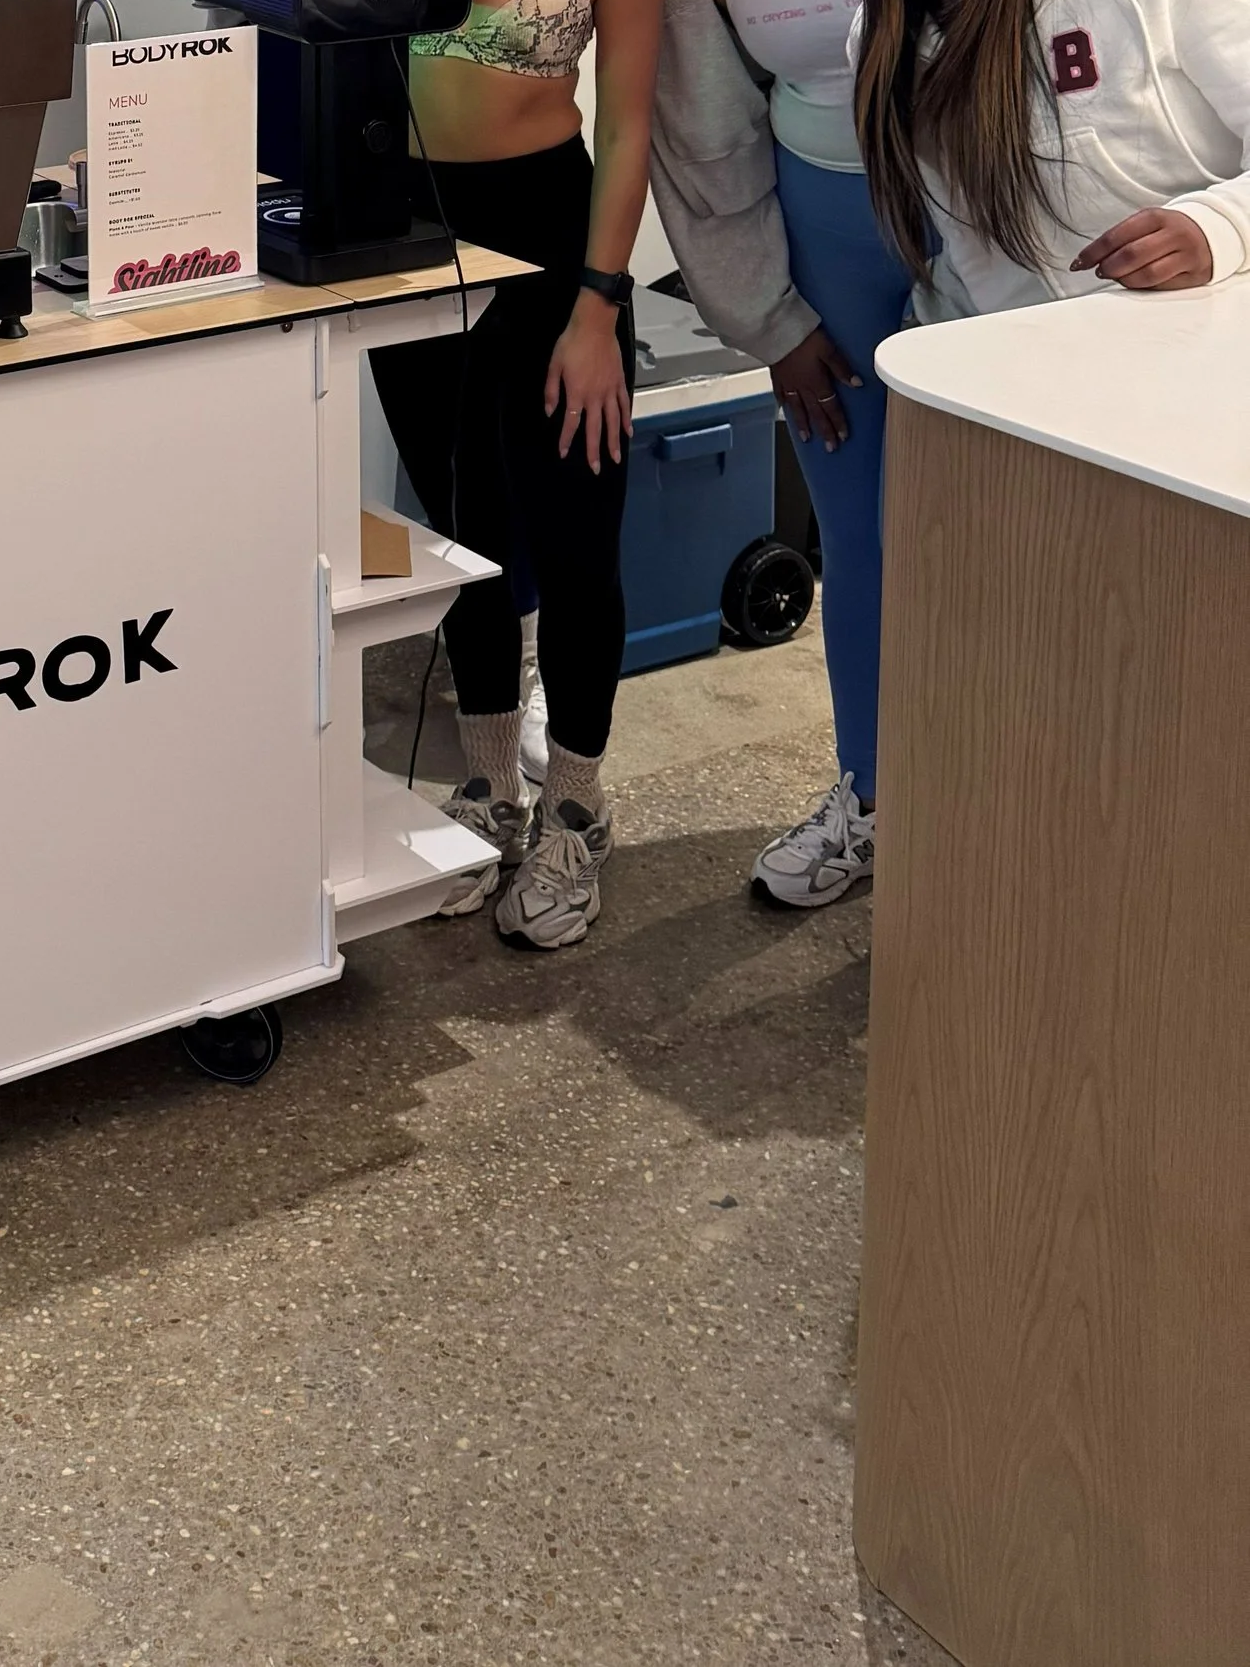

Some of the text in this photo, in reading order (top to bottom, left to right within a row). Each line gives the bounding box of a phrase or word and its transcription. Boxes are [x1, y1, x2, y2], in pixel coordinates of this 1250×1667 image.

[762, 8, 806, 23] CRYING
[815, 2, 833, 13] ON
[111, 36, 234, 67] BODYROK
[1052, 28, 1099, 93] B
[109, 93, 148, 110] MENU
[116, 249, 239, 293] Sightline
